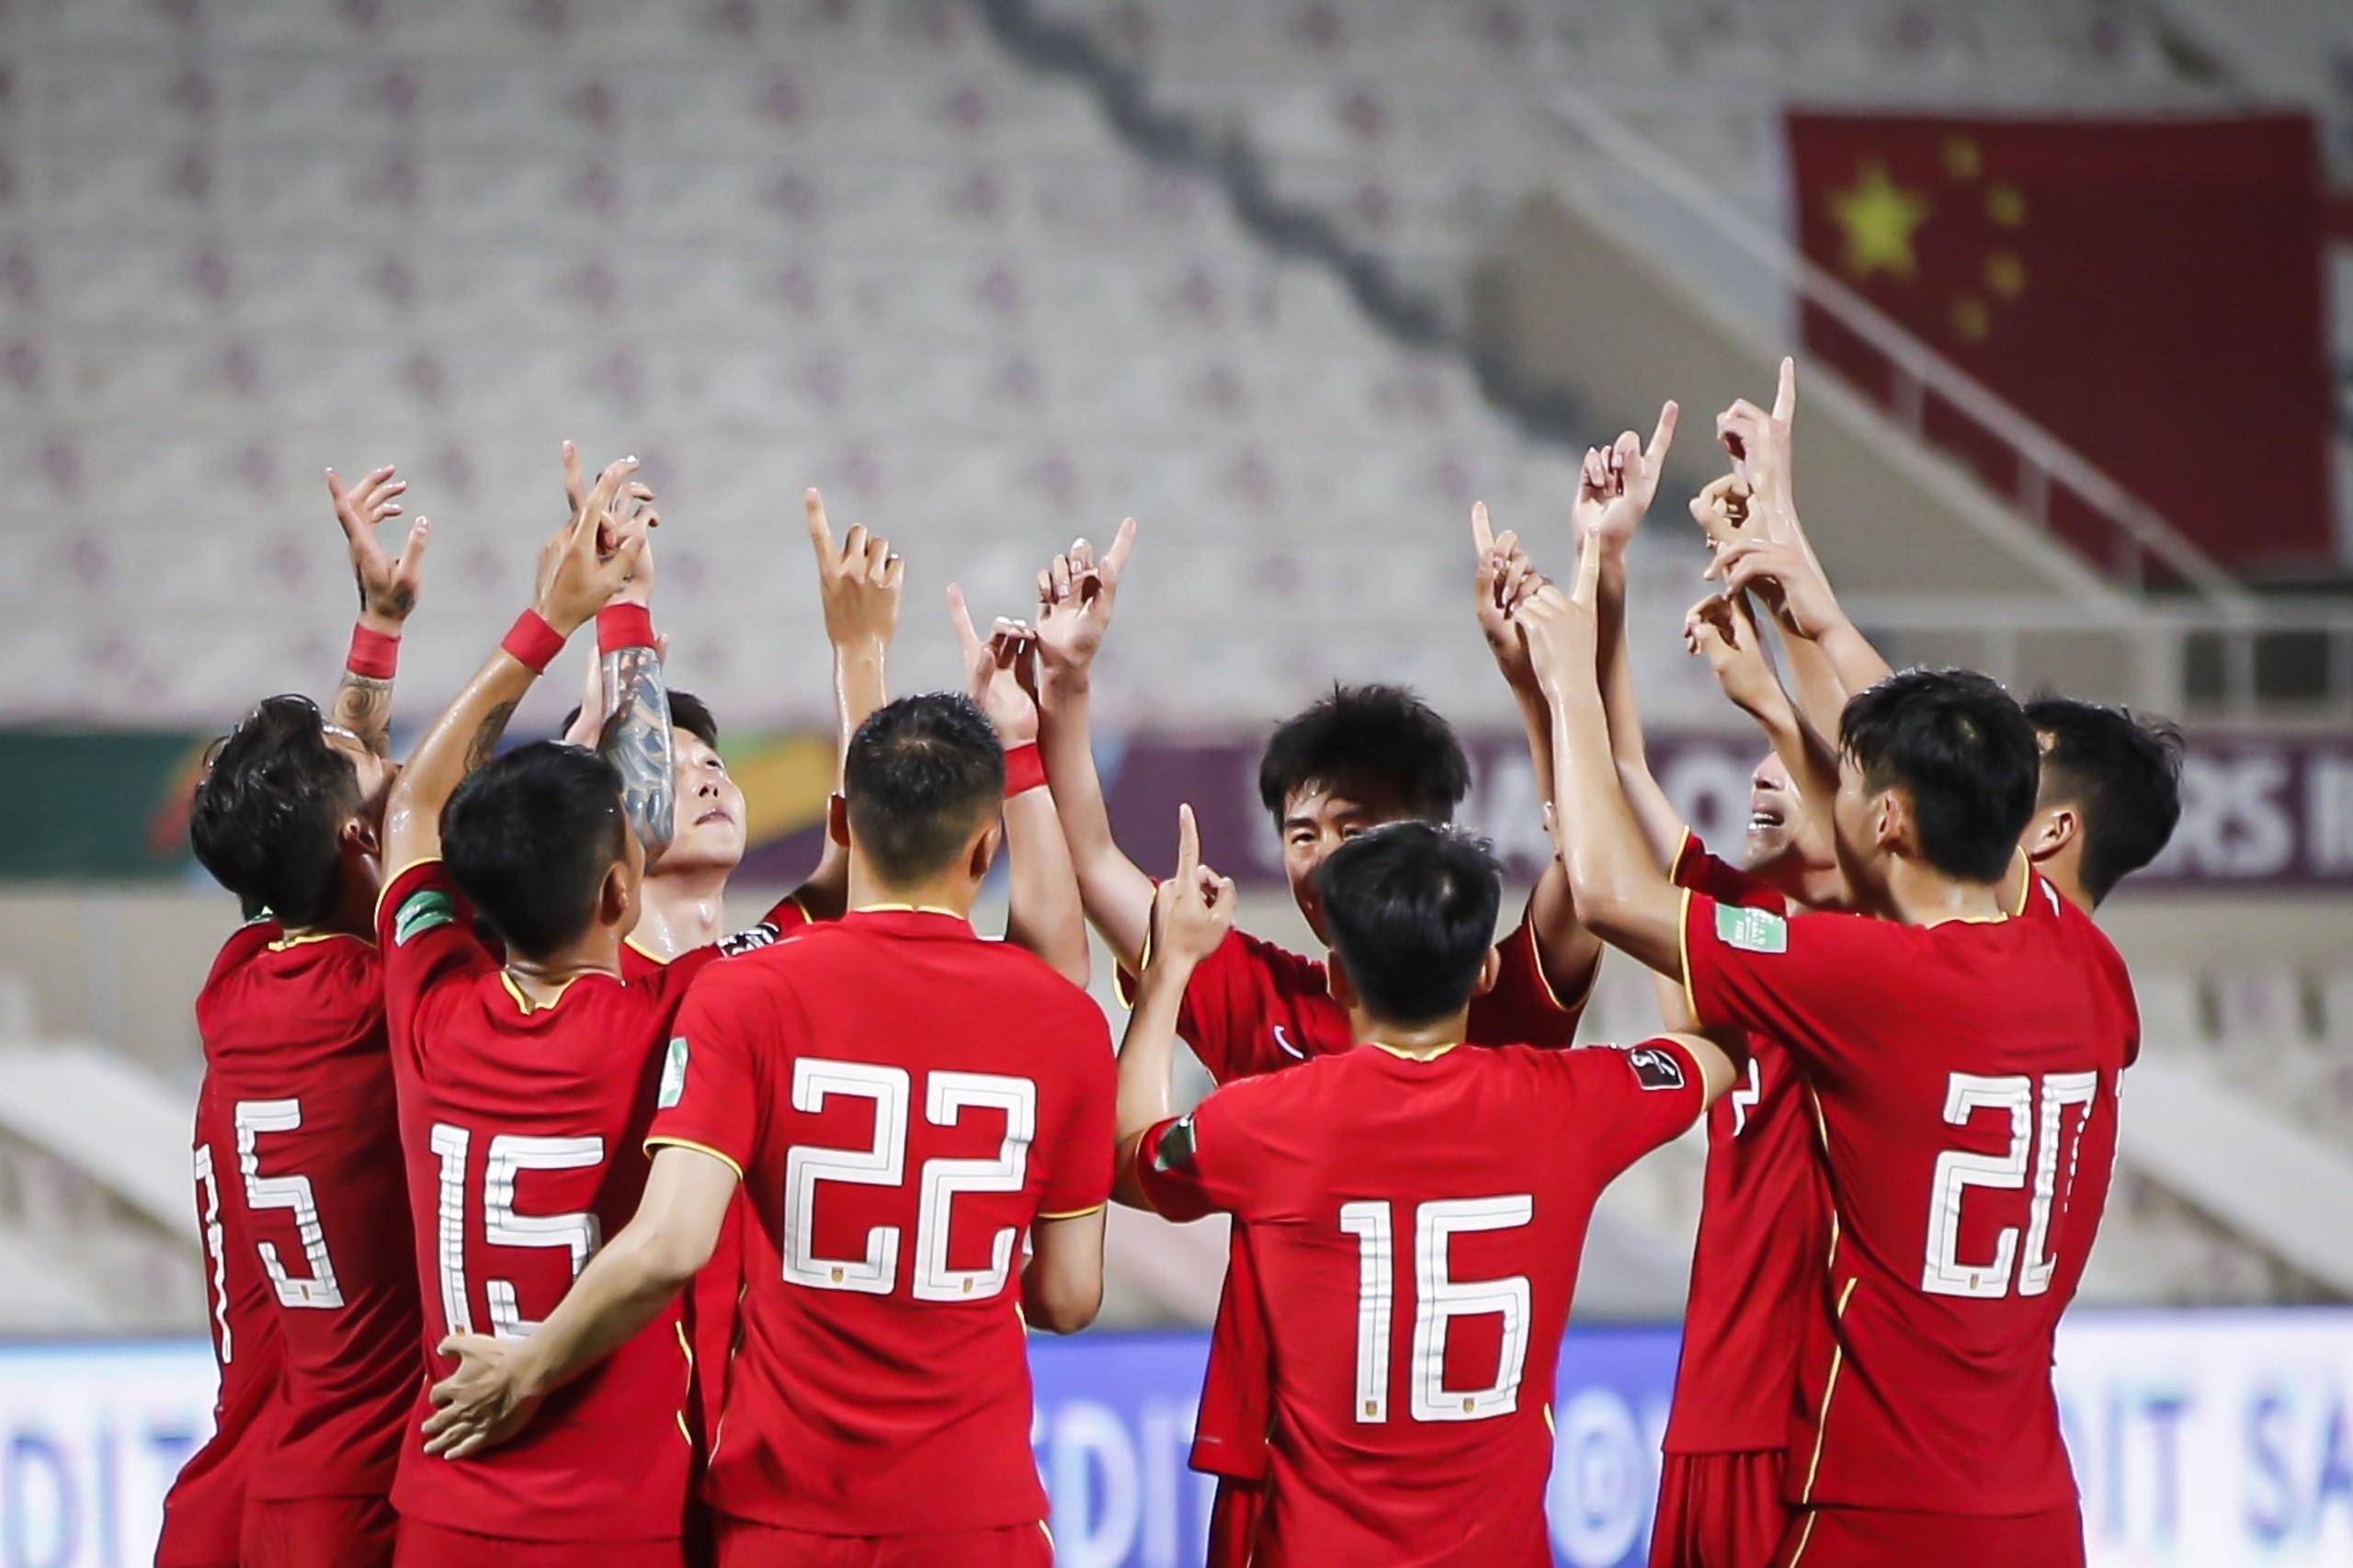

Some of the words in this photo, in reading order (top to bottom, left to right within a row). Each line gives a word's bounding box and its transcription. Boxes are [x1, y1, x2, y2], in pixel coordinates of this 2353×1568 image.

[234, 1098, 344, 1310] 5
[430, 1123, 605, 1338] 15
[782, 1056, 1037, 1301] 22
[1339, 1194, 1533, 1423] 16
